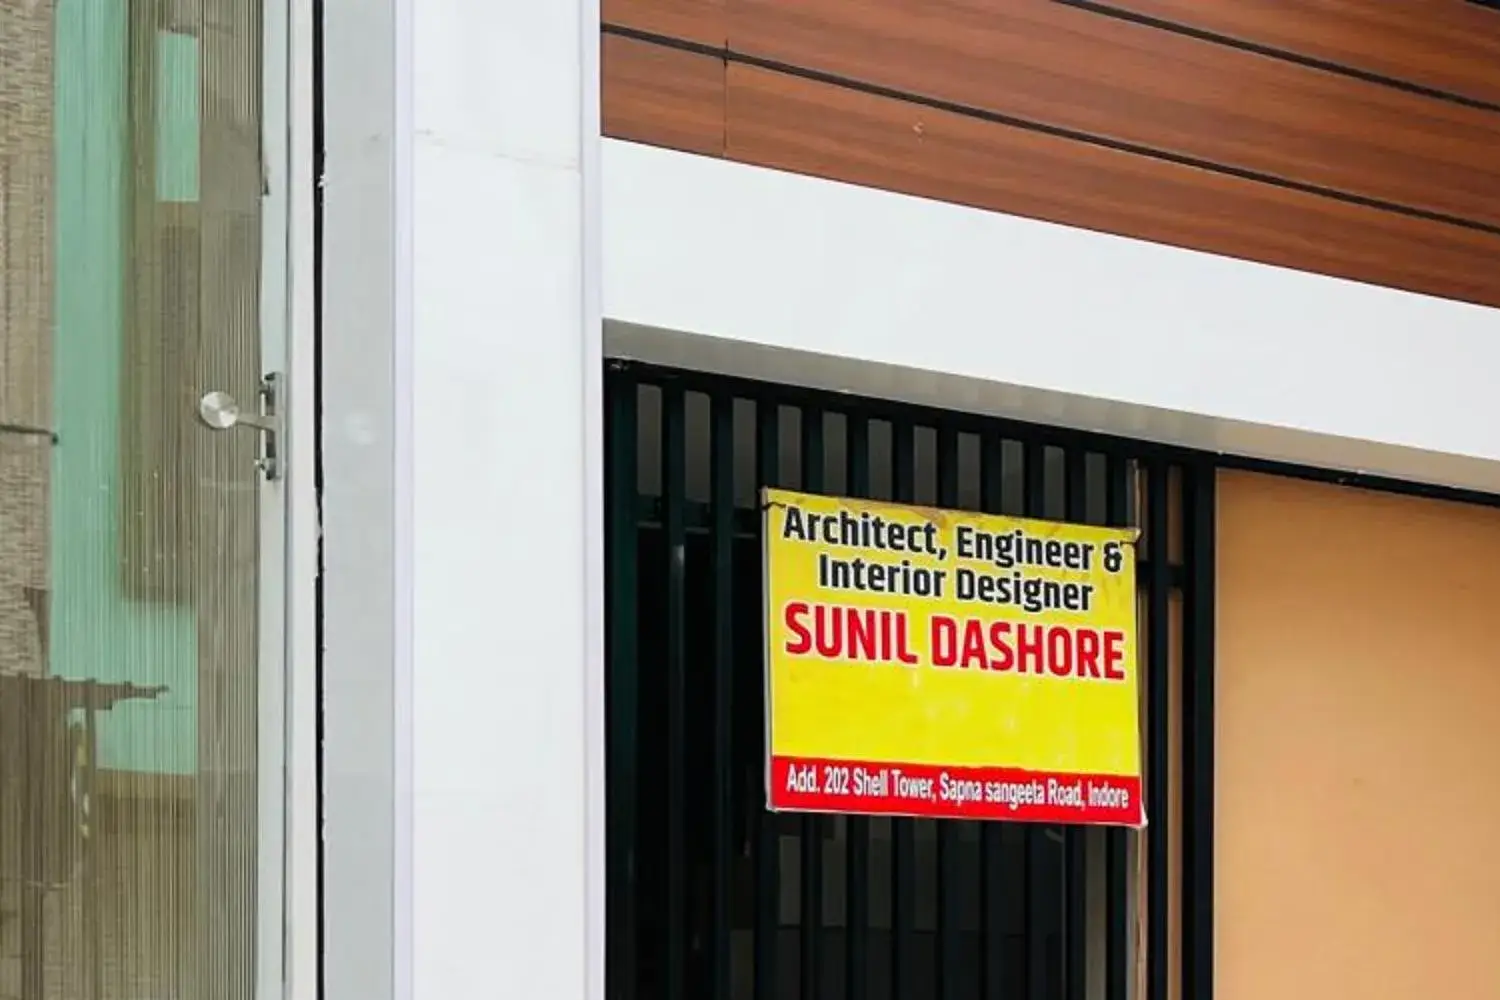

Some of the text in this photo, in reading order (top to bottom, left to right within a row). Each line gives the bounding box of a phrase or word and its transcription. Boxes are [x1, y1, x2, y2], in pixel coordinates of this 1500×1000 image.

[783, 506, 1123, 572] Architect, Engineer &
[819, 554, 1093, 612] Interior Designer
[785, 602, 1125, 680] SUNIL DASHORE
[786, 764, 1129, 811] Add. 202 Shell Tower, Sapna sangeeta Road, Indore
